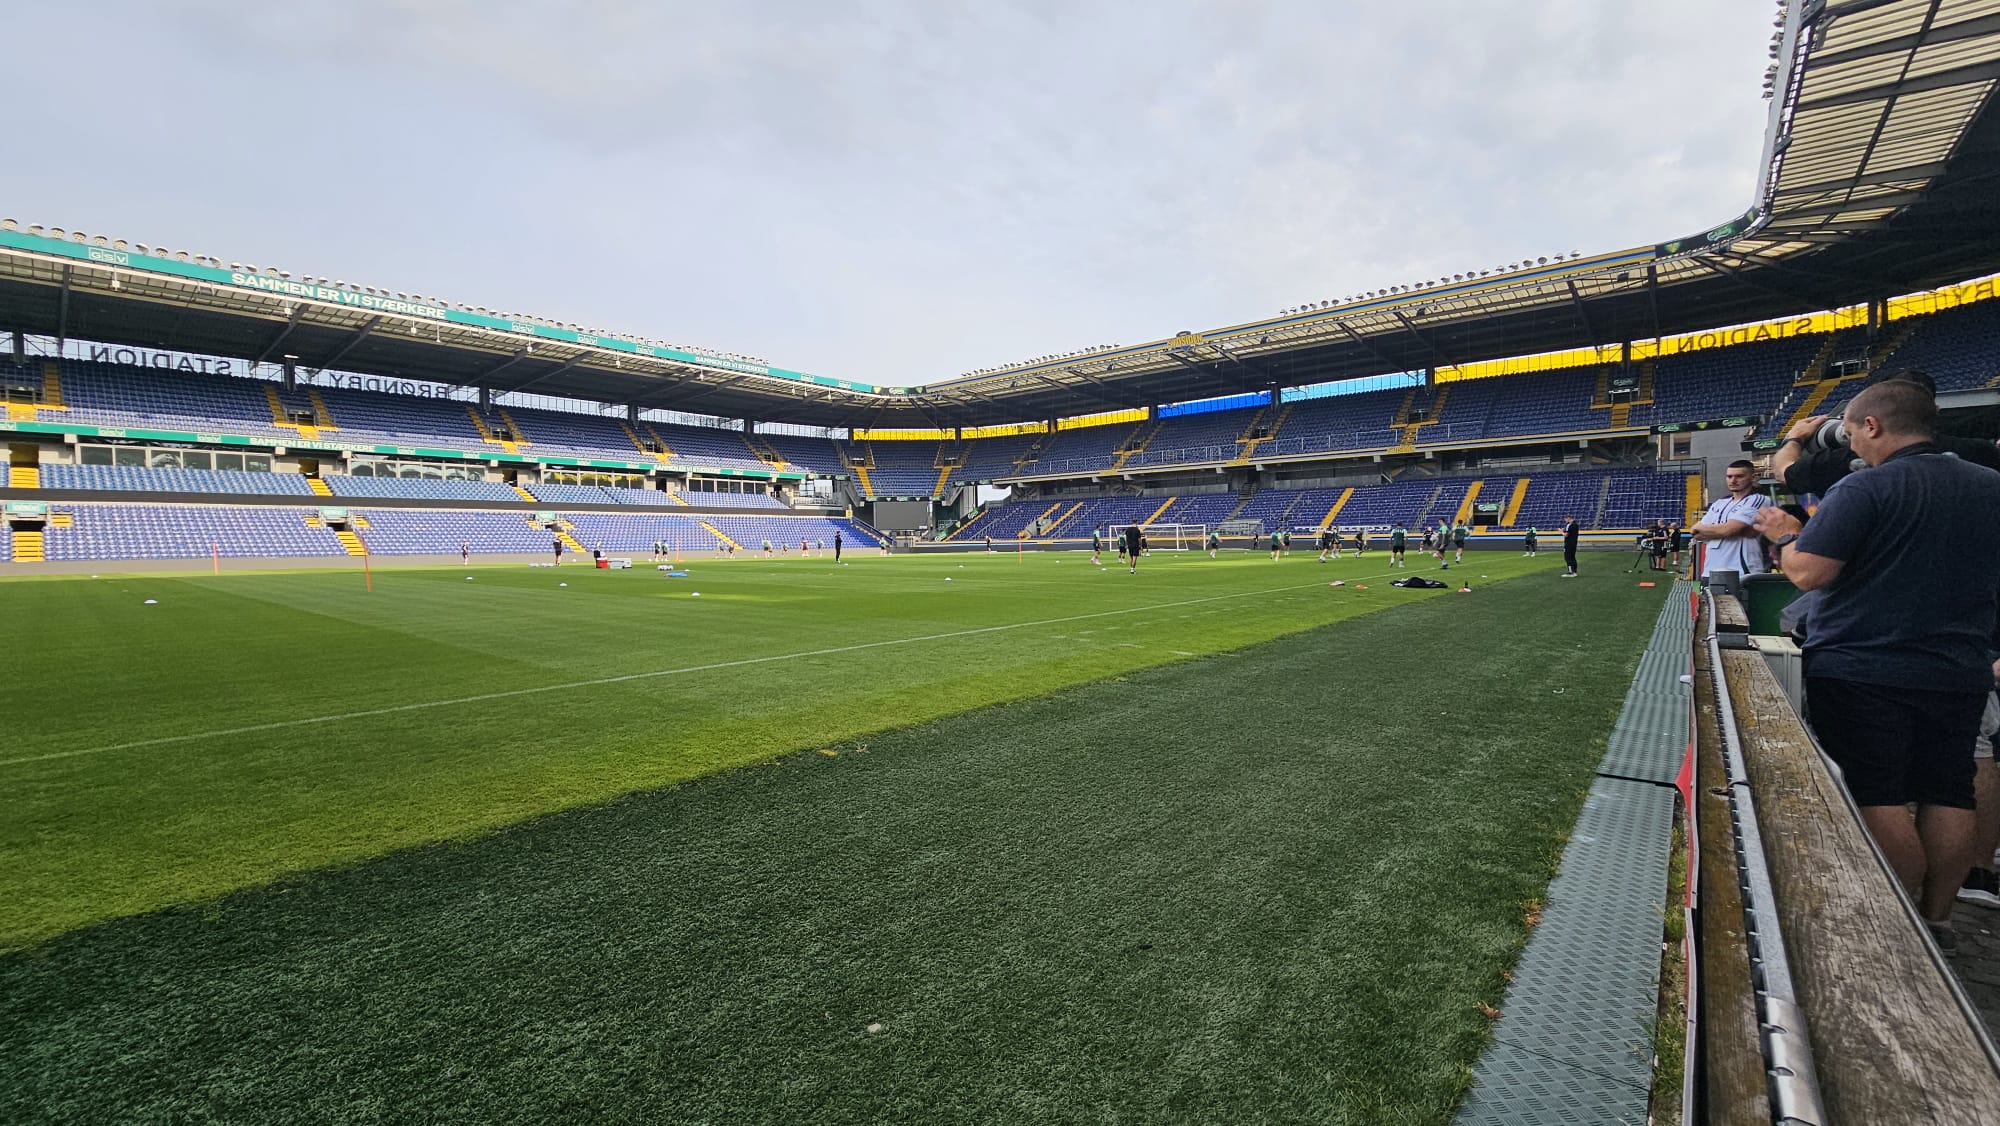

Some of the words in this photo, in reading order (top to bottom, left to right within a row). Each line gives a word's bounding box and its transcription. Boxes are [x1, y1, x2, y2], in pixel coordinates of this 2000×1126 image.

[231, 273, 314, 297] SAMMEN
[317, 287, 339, 302] ER
[341, 291, 359, 304] VI
[361, 295, 446, 319] STÆRKERE
